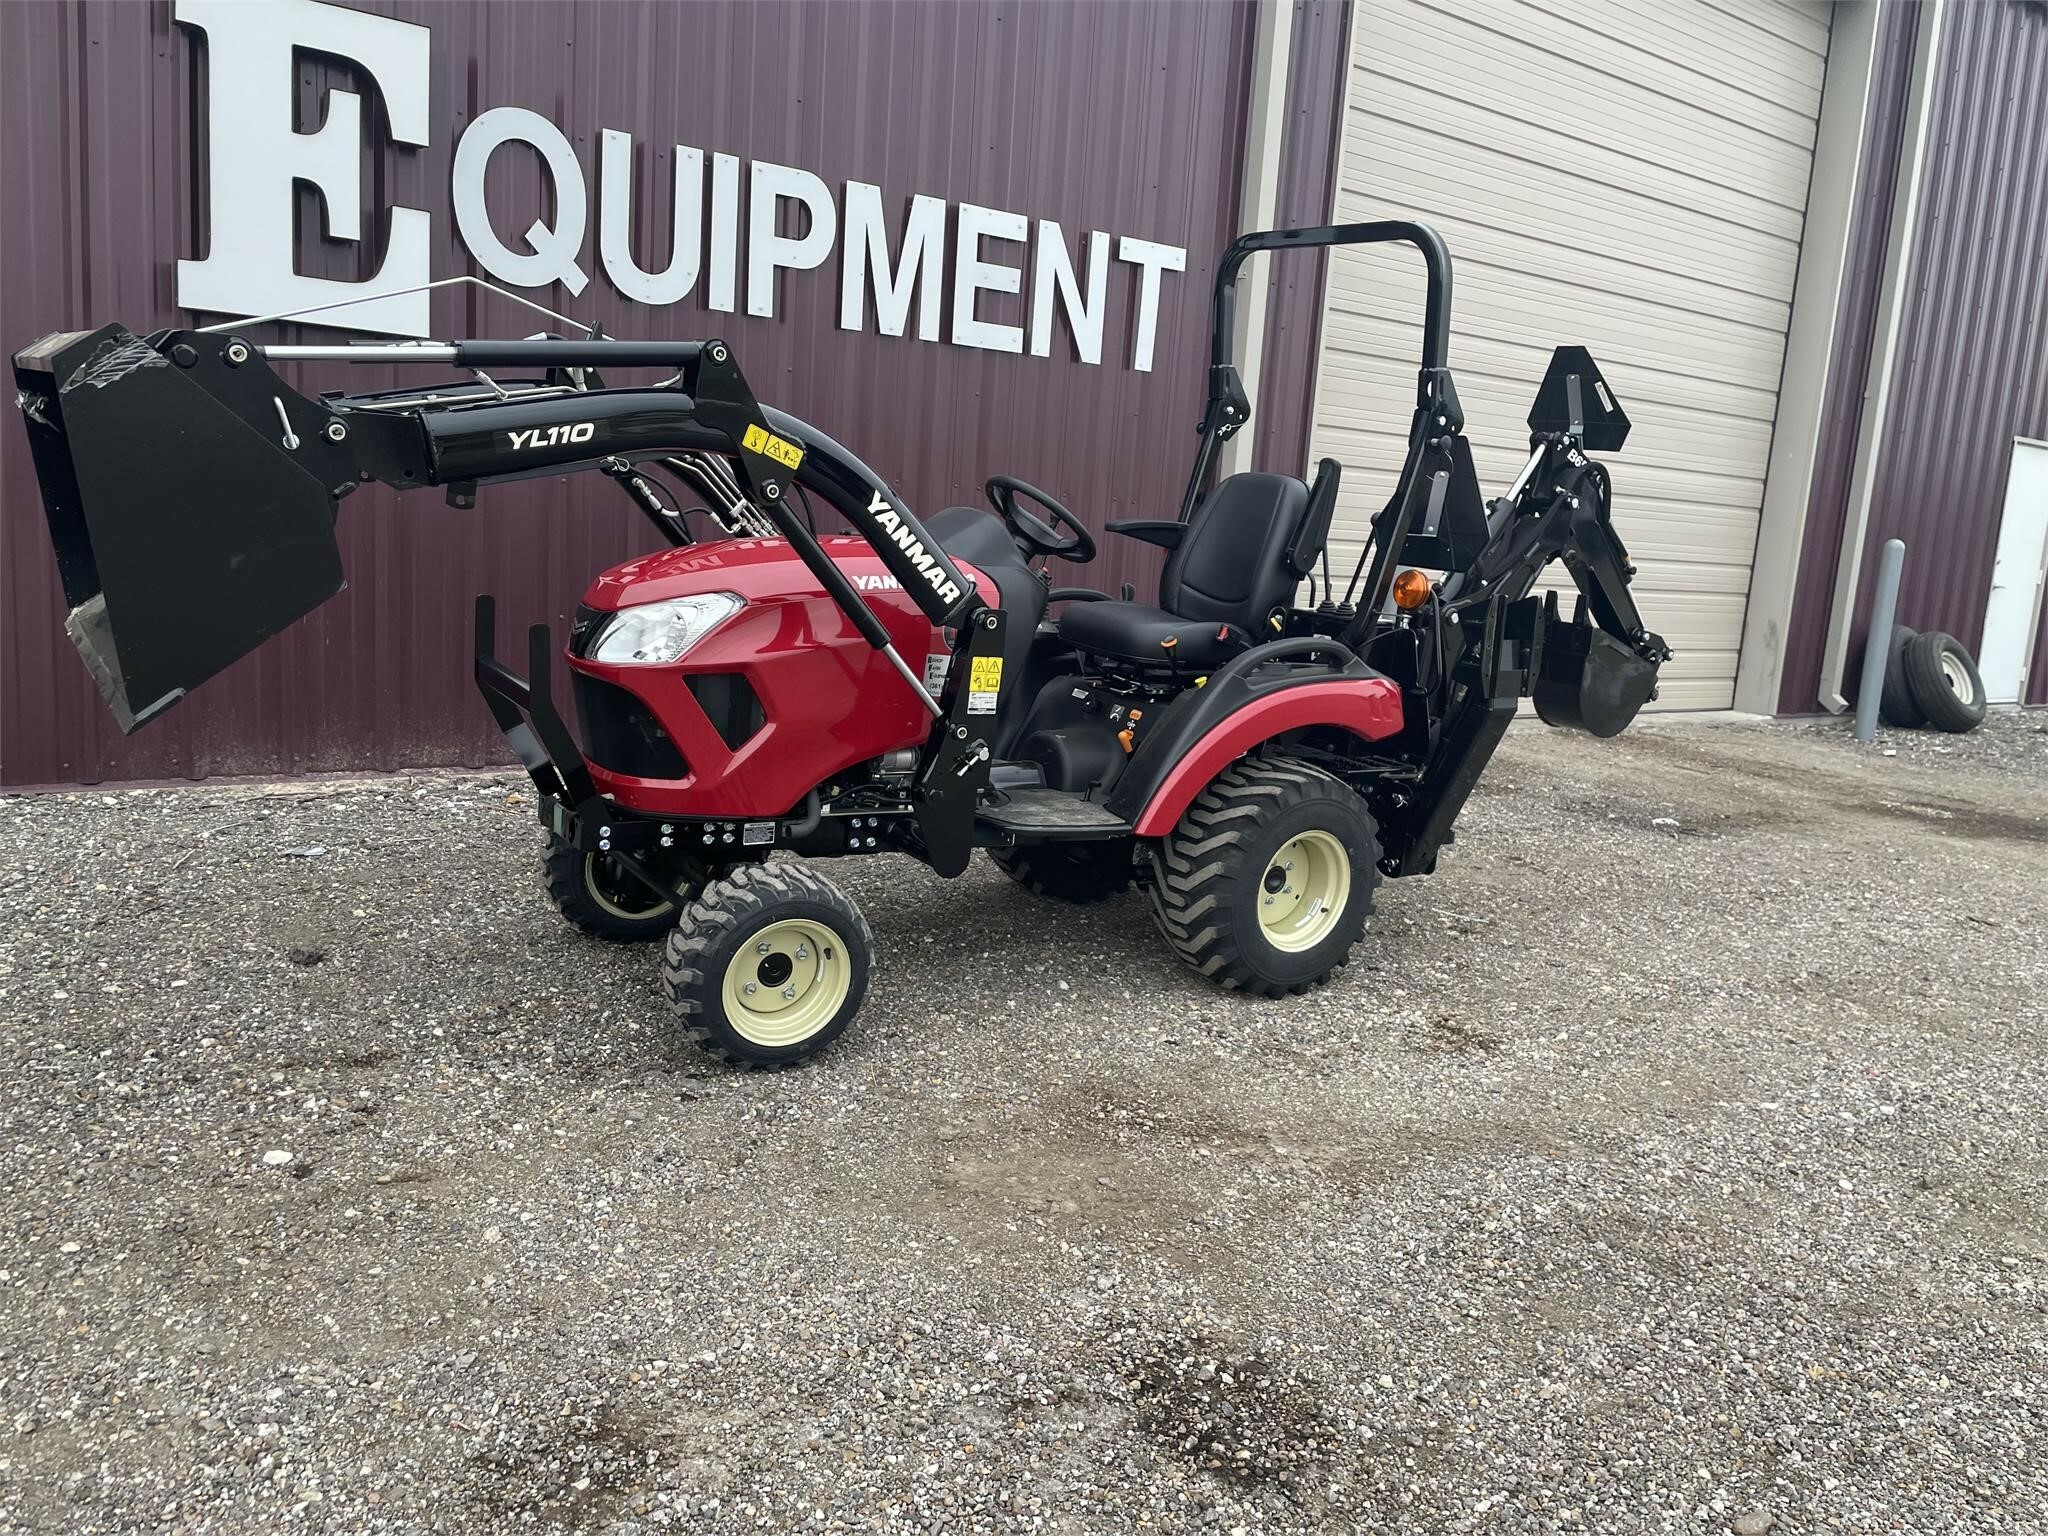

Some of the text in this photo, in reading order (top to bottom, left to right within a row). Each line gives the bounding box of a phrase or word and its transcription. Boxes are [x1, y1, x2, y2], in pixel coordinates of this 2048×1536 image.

[175, 0, 1187, 372] EQUIPMENT
[508, 423, 595, 450] YL110
[852, 575, 904, 590] YAN
[867, 490, 961, 605] YANMAR
